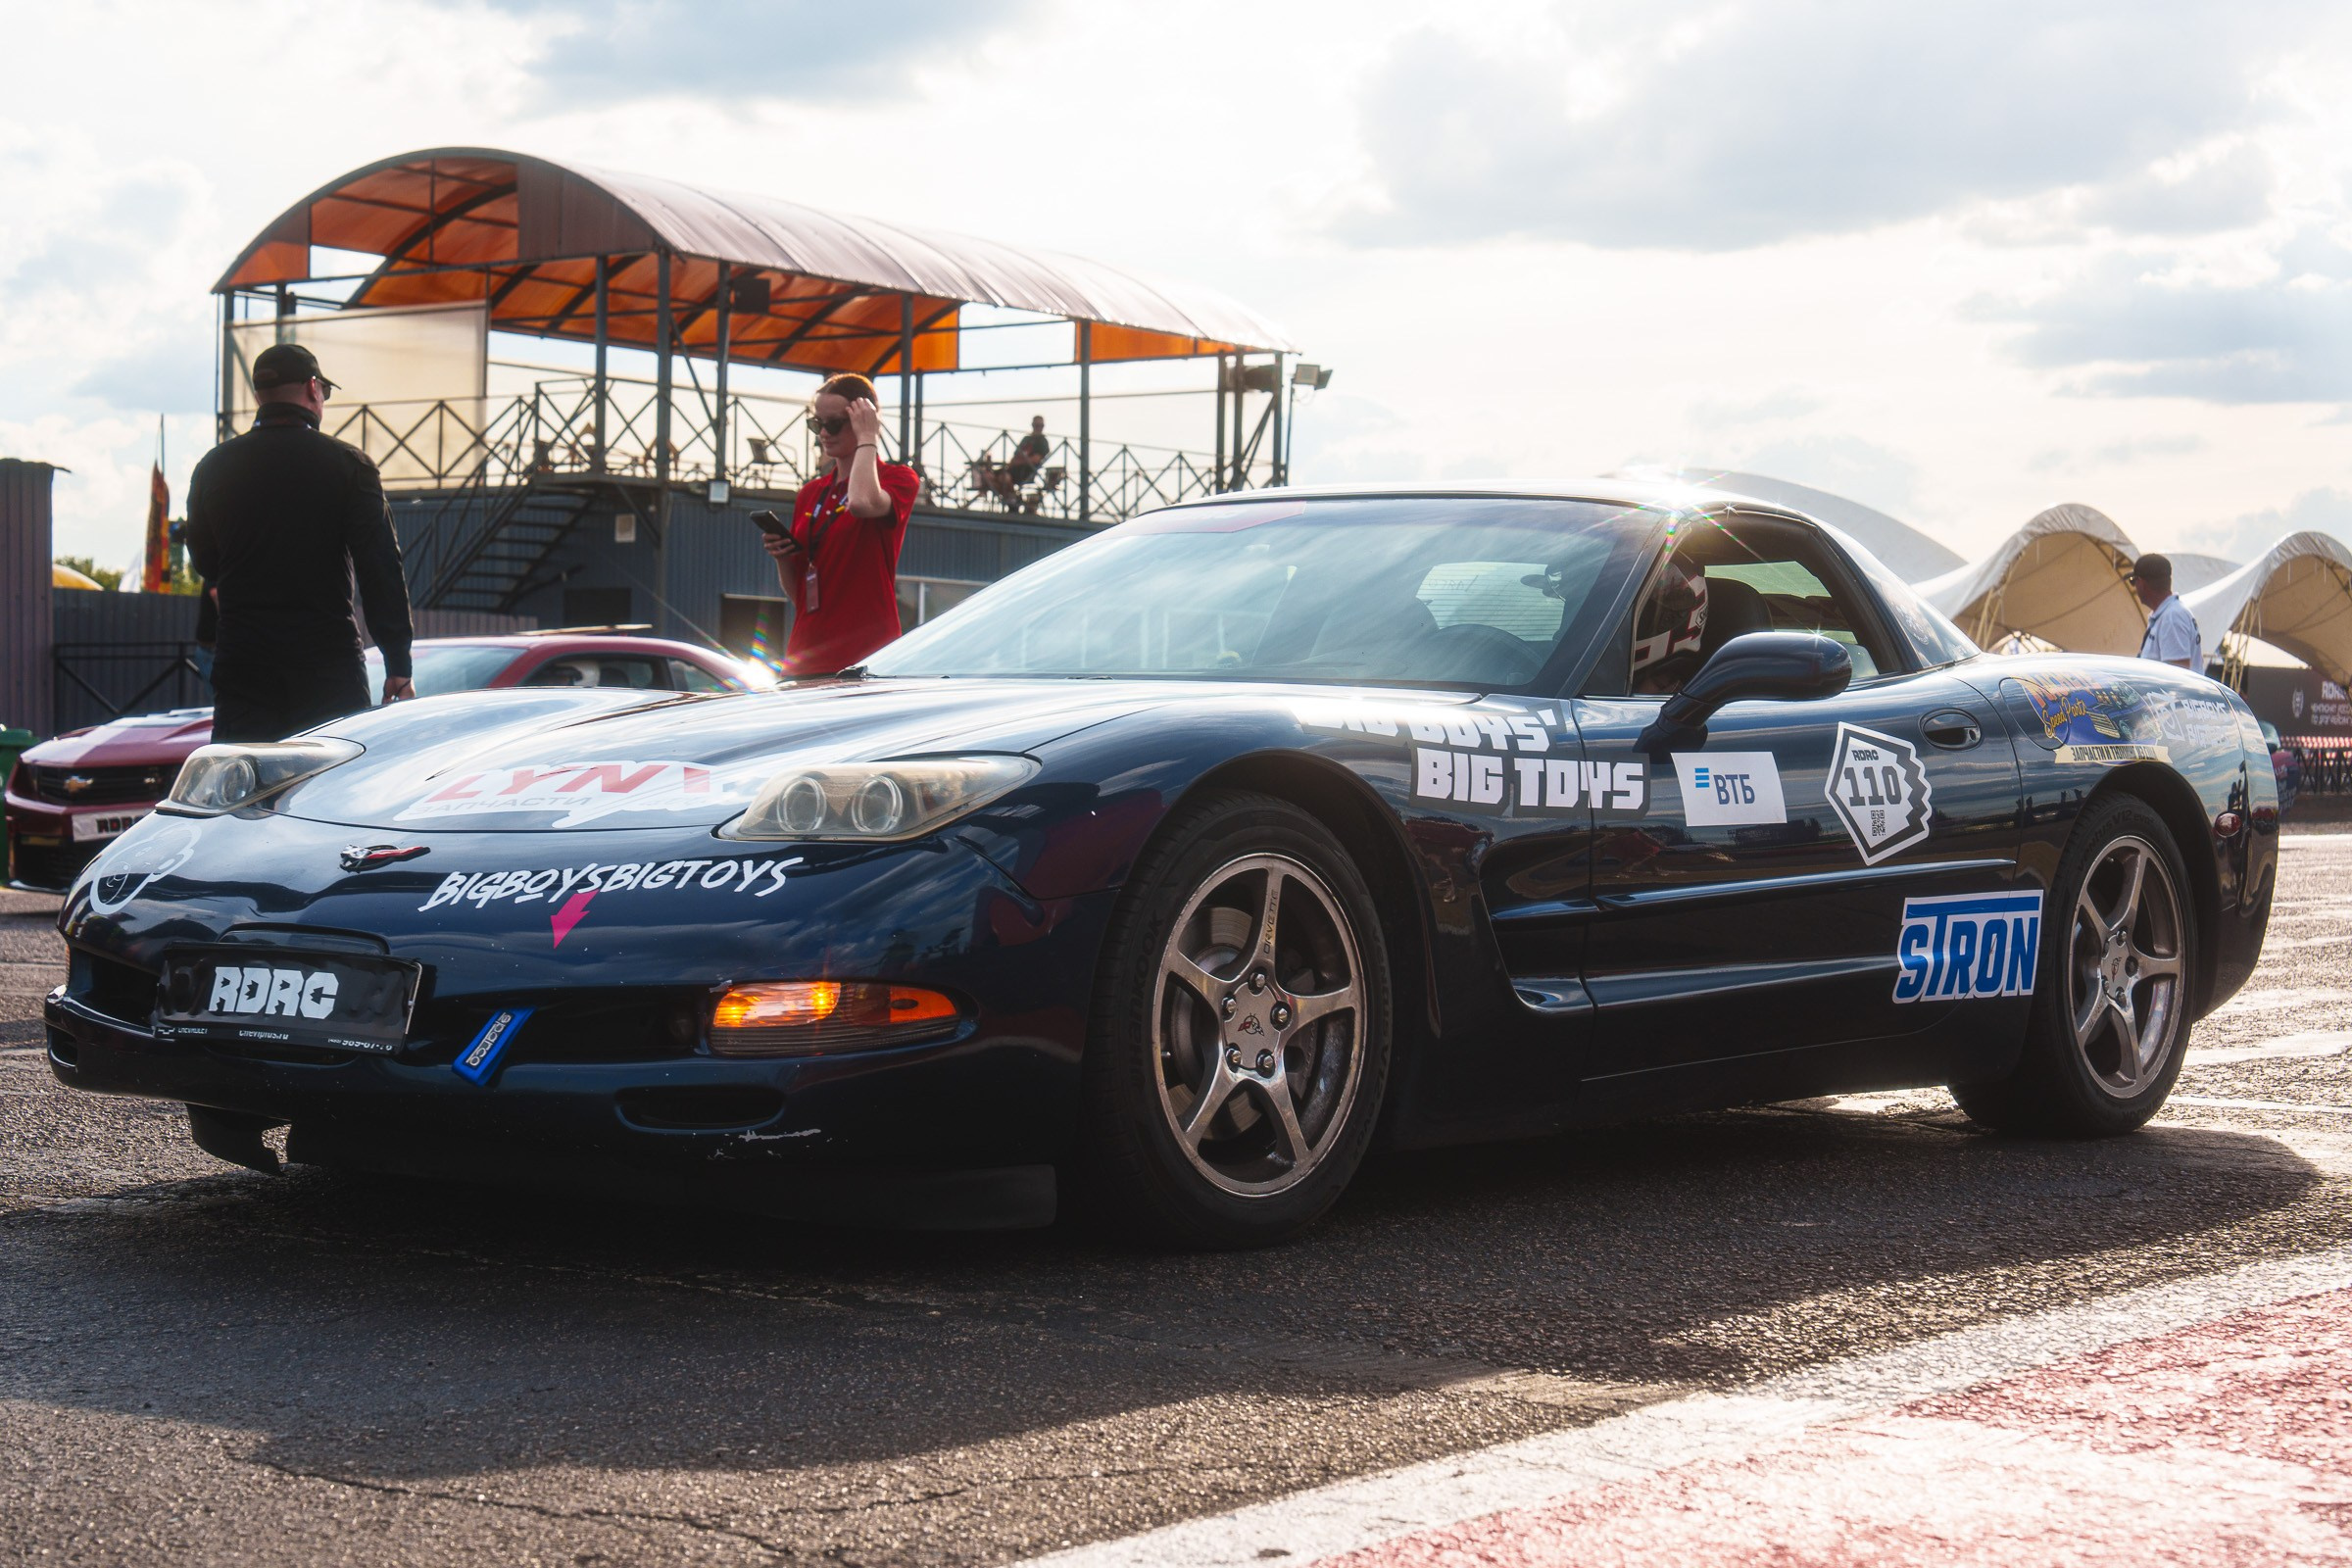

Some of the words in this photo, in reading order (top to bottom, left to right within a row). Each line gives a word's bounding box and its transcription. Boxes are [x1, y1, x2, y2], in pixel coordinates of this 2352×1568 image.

[1417, 748, 1503, 805] BIG
[1514, 758, 1643, 810] TOYS
[1851, 750, 1880, 761] RDRC
[1713, 773, 1755, 806] ВТБ
[1843, 765, 1902, 807] 110
[417, 857, 806, 912] BIGBOYSBIGTOYS
[1895, 896, 2040, 1000] STRON
[208, 966, 339, 1020] RDRC
[469, 1012, 512, 1066] sparco
